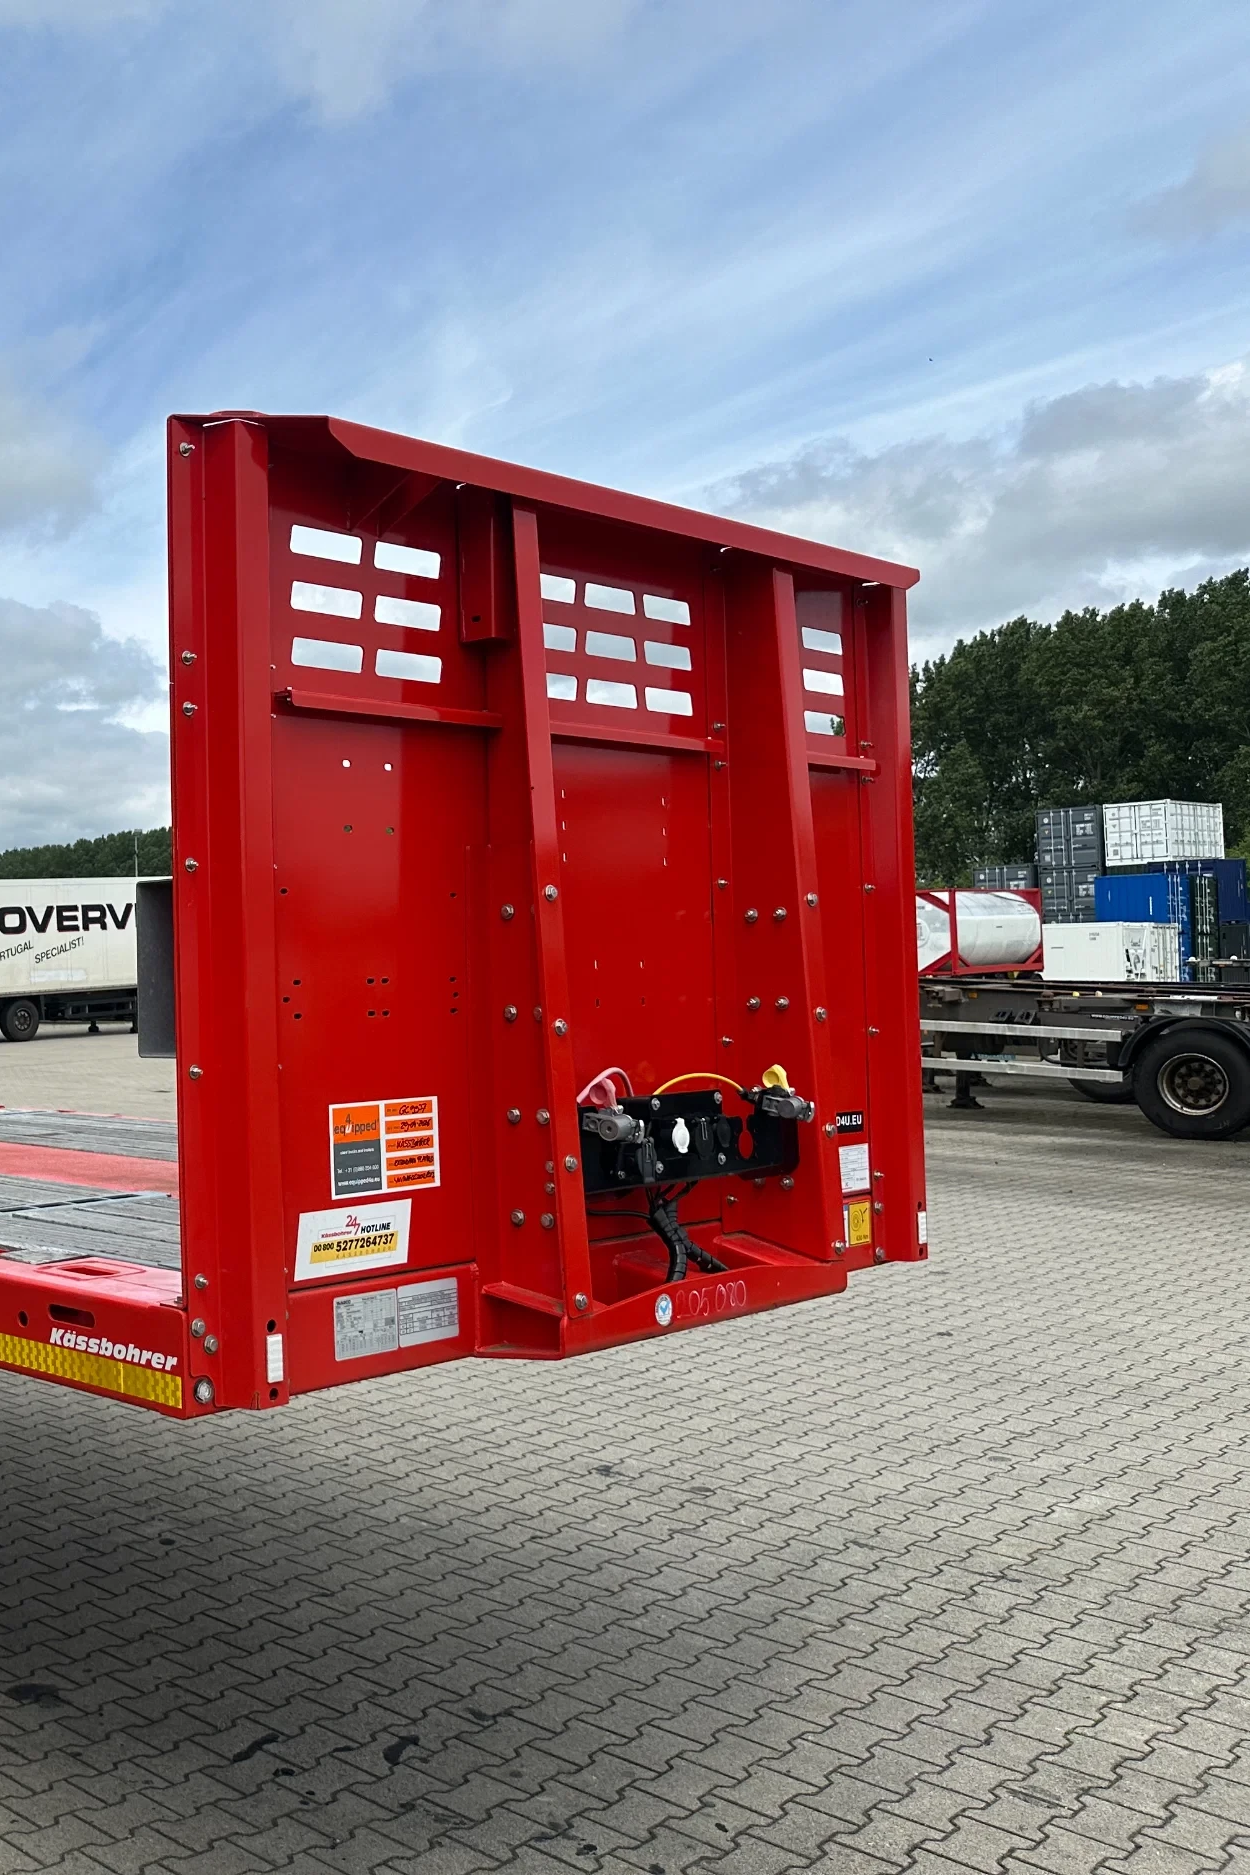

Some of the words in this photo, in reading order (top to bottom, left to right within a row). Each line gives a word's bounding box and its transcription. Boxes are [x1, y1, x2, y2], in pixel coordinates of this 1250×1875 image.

[34, 936, 85, 964] SPECIALIST!
[360, 1222, 391, 1234] HOTLINE
[335, 1233, 395, 1253] 5277264737
[49, 1327, 178, 1371] Kässbohrer
